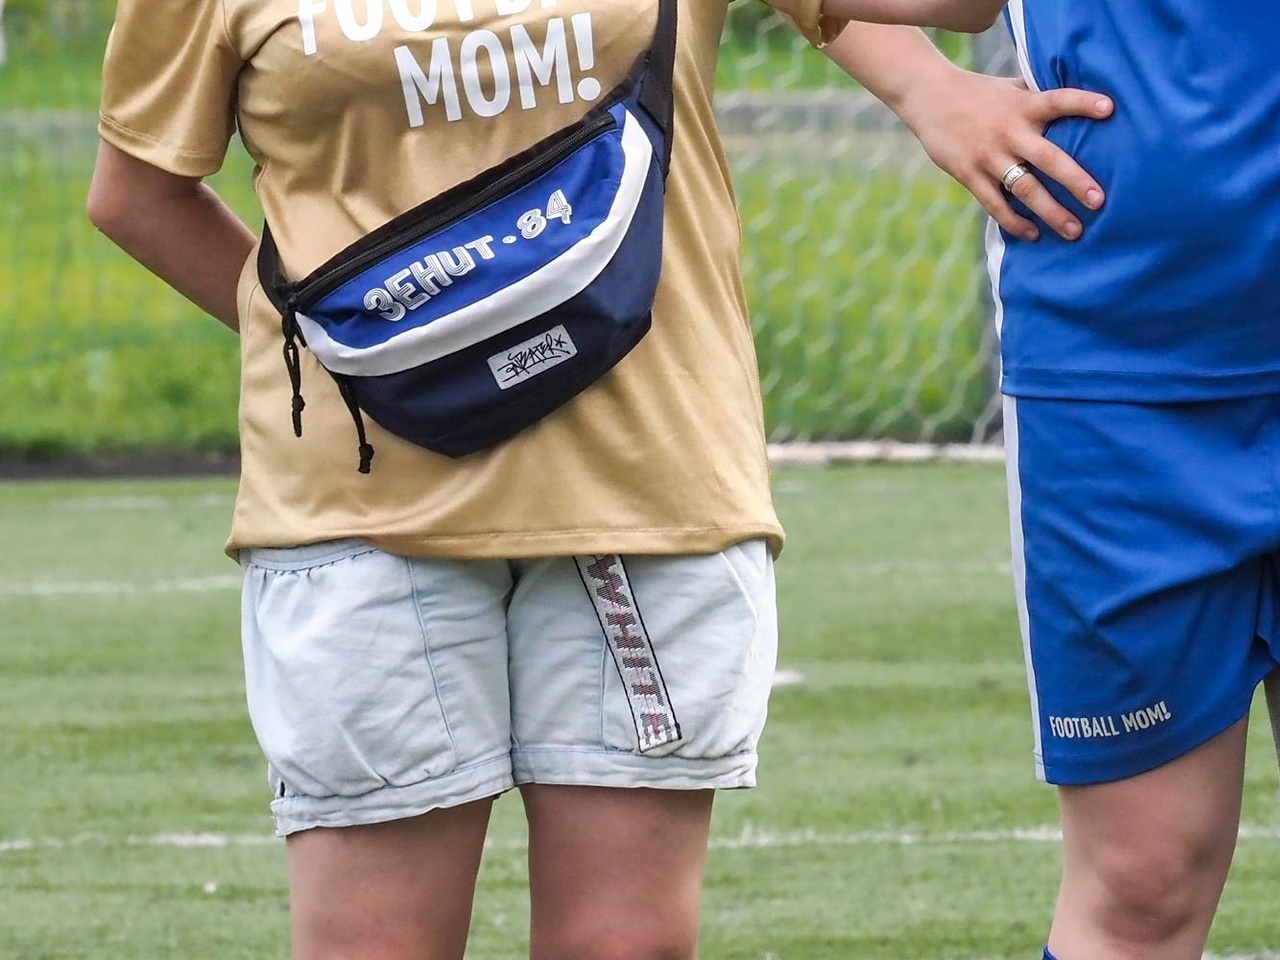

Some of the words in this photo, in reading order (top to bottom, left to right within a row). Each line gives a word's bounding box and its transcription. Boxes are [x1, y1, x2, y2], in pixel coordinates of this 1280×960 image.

[393, 12, 601, 128] MOM!
[1049, 715, 1120, 738] FOOTBALL
[1121, 700, 1172, 733] MOM!
